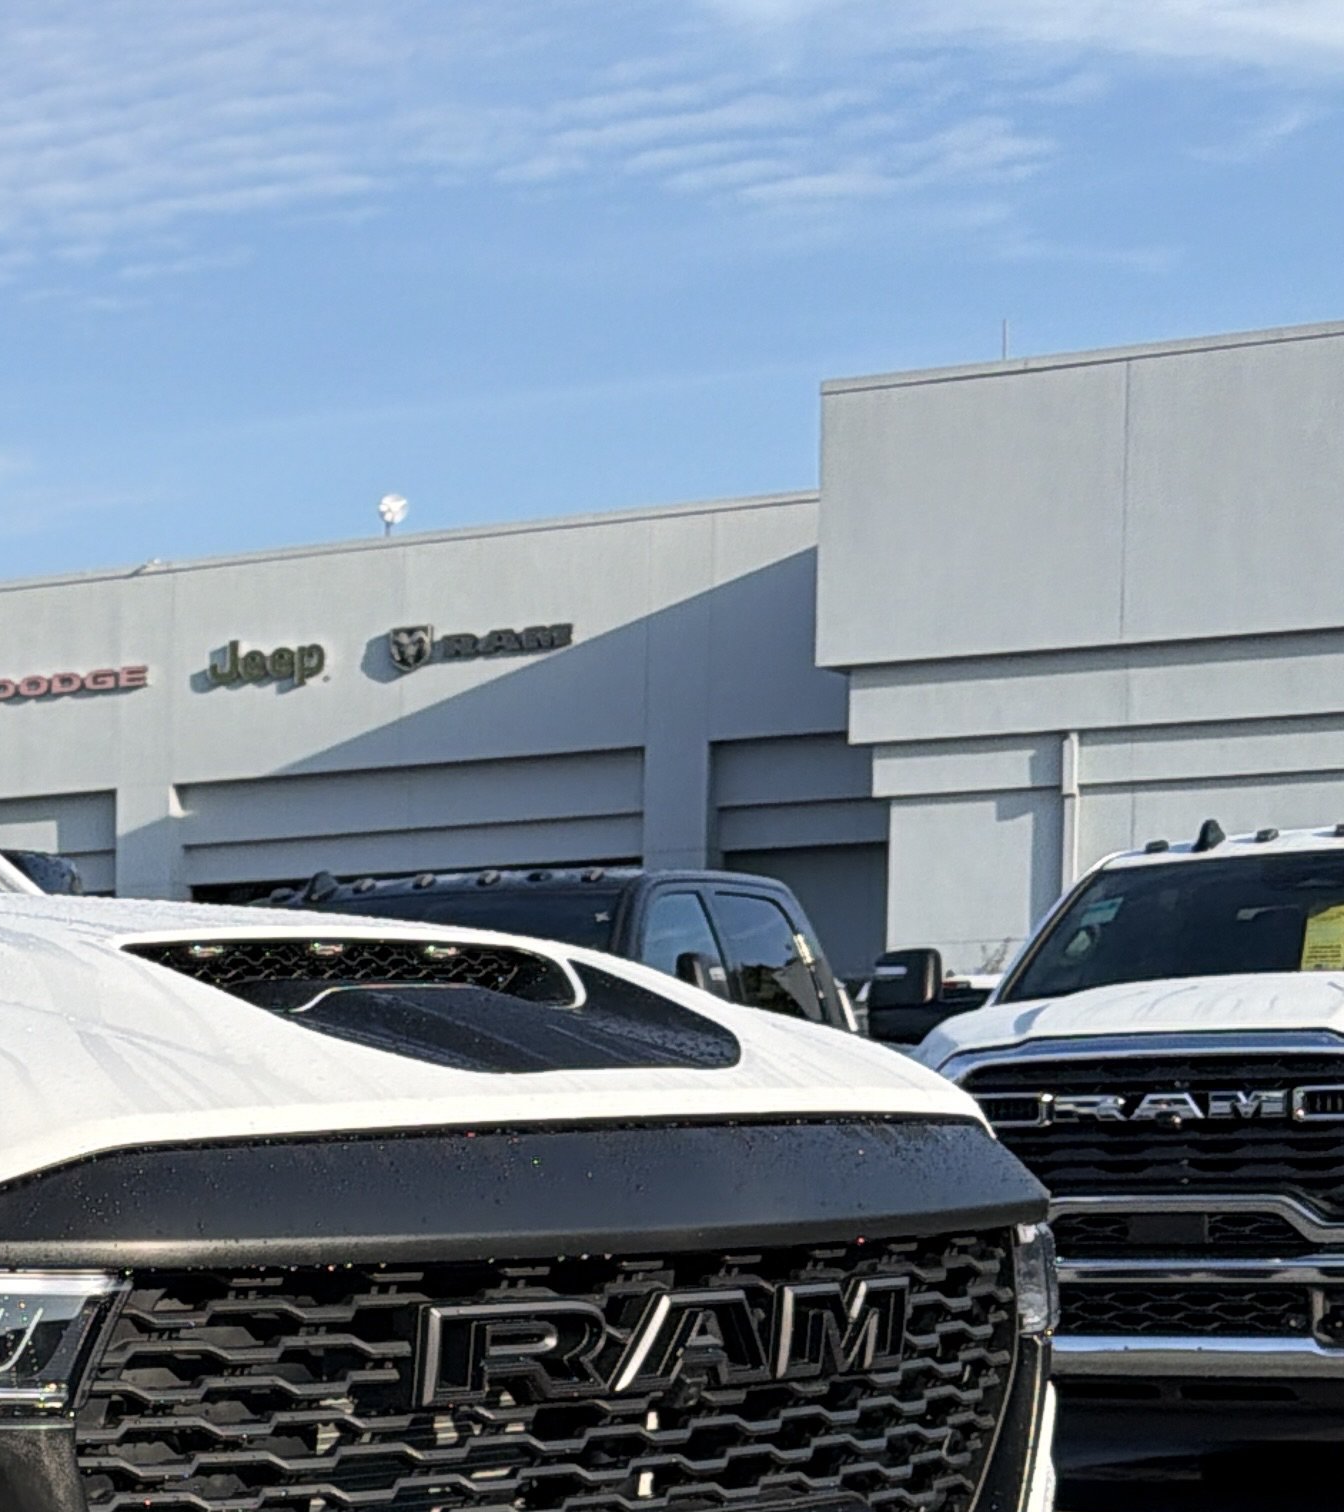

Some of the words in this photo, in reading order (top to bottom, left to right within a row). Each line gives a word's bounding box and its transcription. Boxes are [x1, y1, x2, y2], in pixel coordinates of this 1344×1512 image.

[442, 623, 573, 657] RAM
[209, 640, 325, 685] Jeep
[1054, 1090, 1289, 1122] RAM
[416, 1276, 910, 1407] RAM
